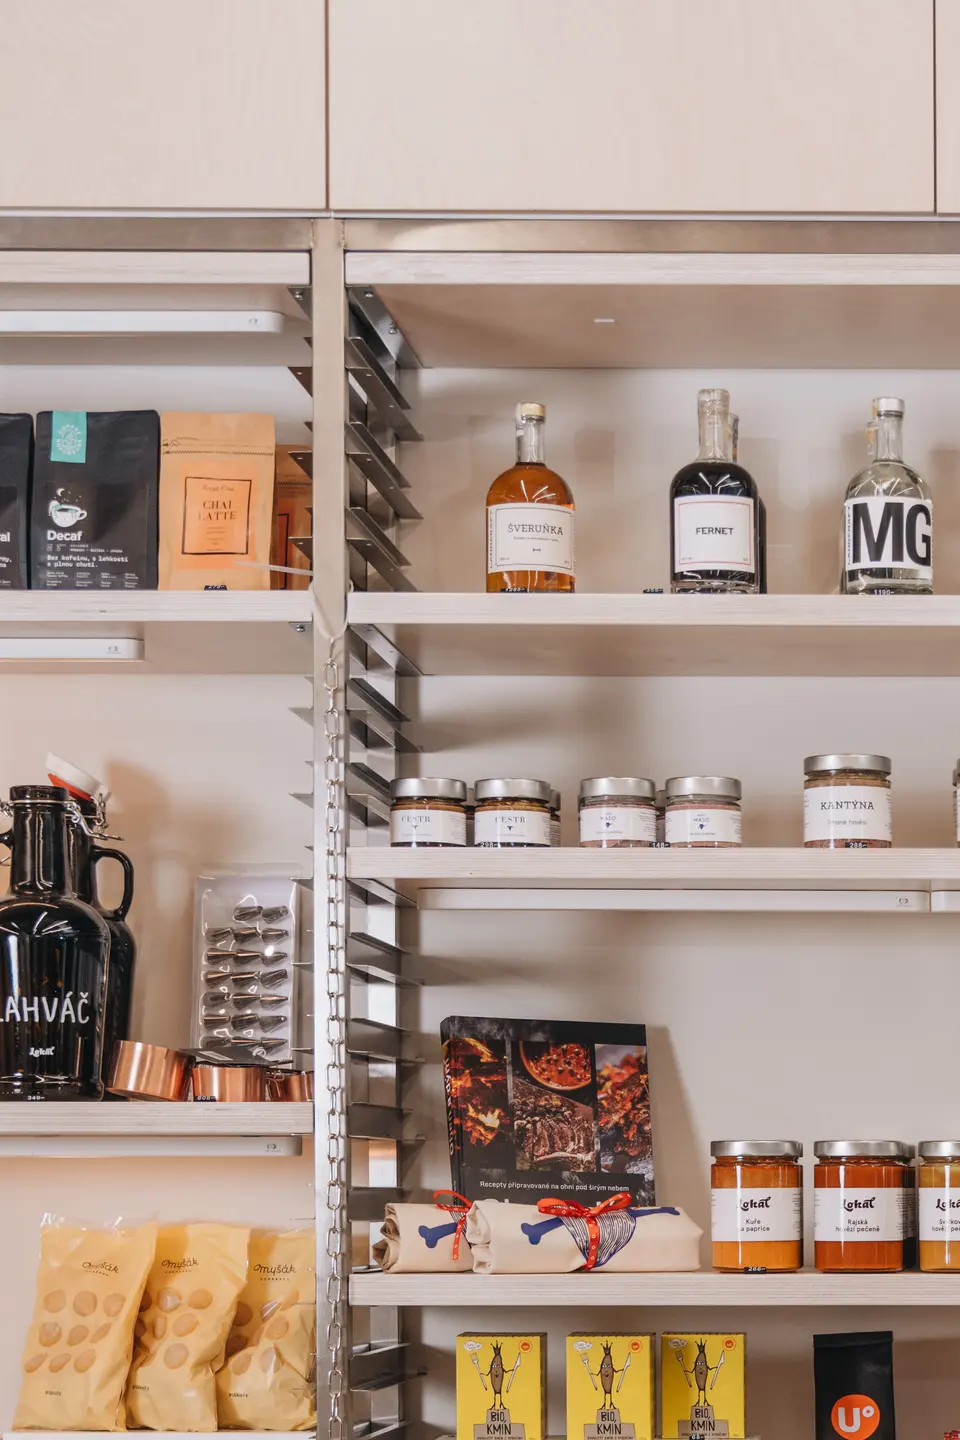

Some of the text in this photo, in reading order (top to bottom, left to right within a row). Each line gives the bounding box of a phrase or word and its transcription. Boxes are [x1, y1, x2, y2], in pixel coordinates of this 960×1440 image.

[203, 500, 232, 509] CHAI
[198, 511, 237, 520] LATTE
[47, 530, 82, 541] Decaf
[695, 527, 734, 535] FERNET
[852, 502, 931, 567] MG
[820, 800, 875, 810] KANTÝNA
[480, 1181, 507, 1189] Recepty
[508, 1182, 550, 1190] připravované
[848, 1218, 868, 1226] Rajská
